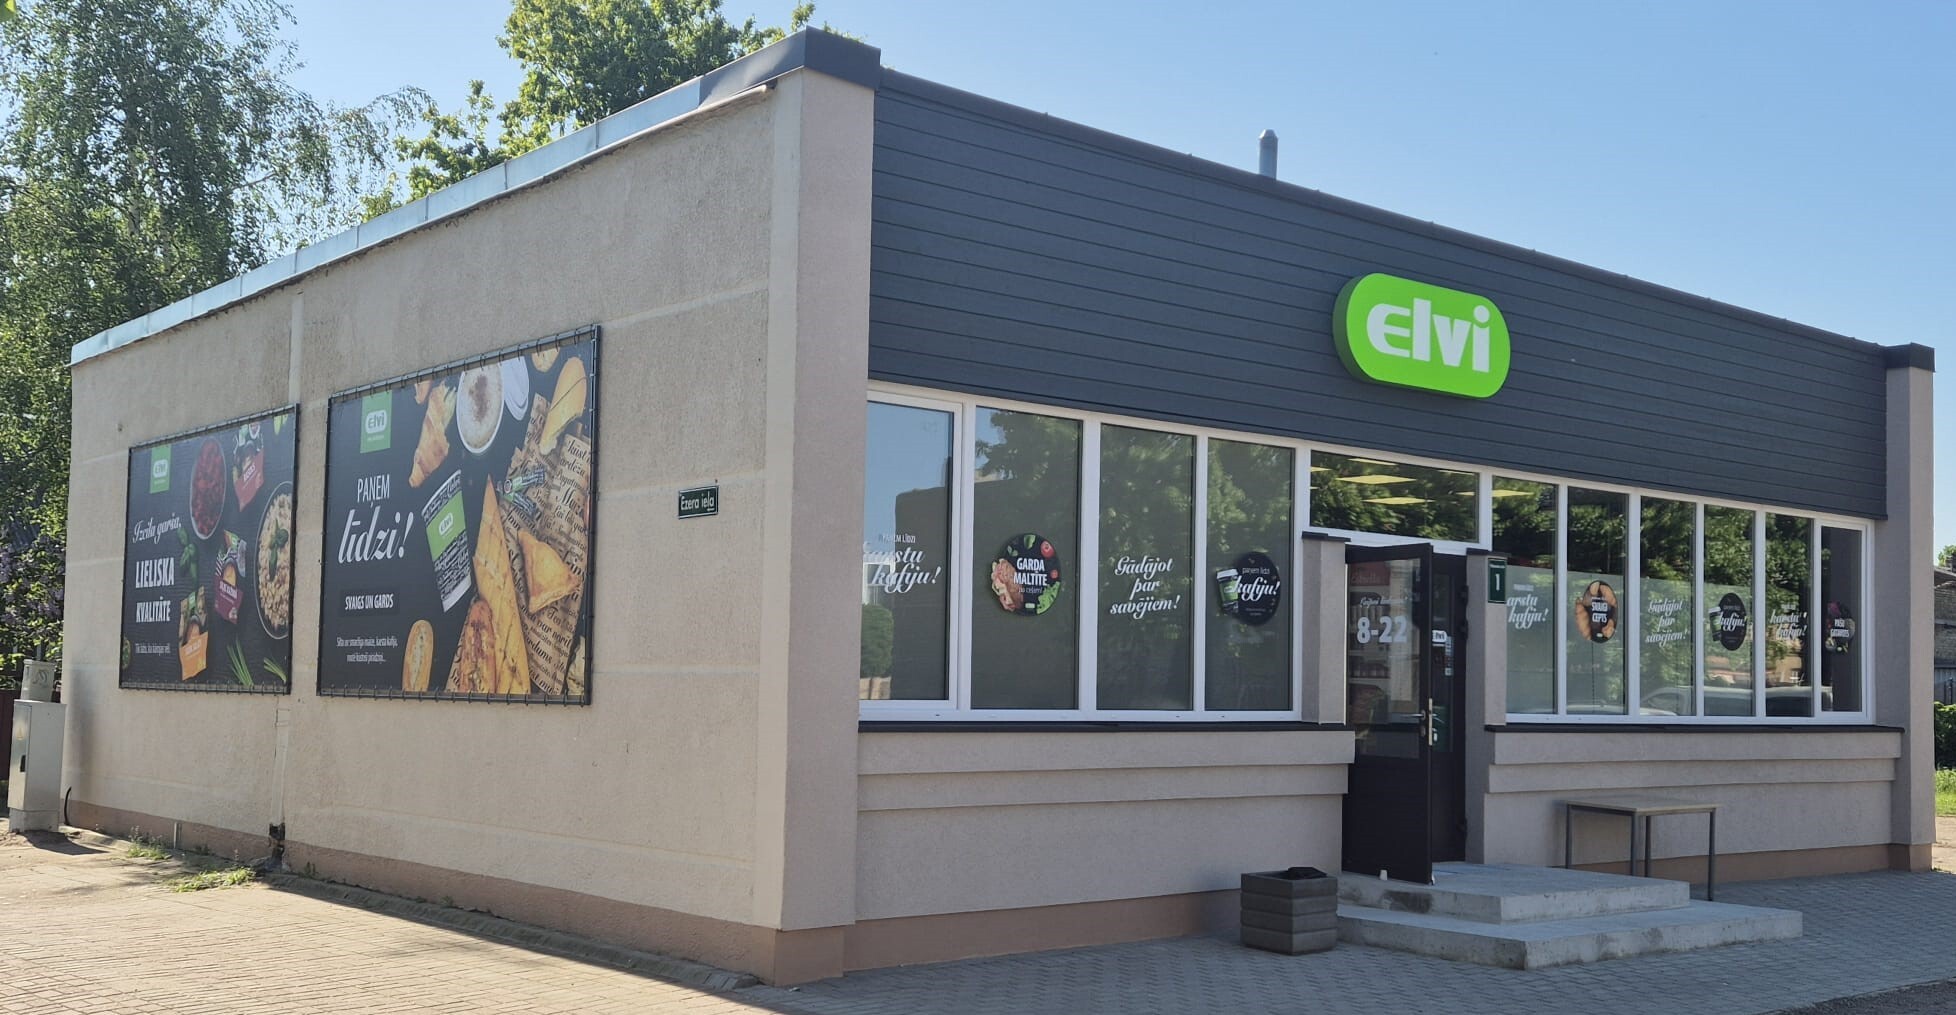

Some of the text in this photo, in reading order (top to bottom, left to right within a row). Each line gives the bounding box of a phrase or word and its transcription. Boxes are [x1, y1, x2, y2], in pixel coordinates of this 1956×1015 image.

[357, 474, 390, 508] PAŅEM
[681, 491, 715, 510] Ezera iela
[338, 505, 414, 563] līdzi!
[135, 557, 175, 589] LIELISKA
[1016, 558, 1045, 571] GARDA
[1115, 555, 1173, 580] Gādājot
[871, 563, 942, 593] kafiju!
[1014, 570, 1048, 586] MALTĪTE
[1129, 578, 1160, 600] par
[1233, 575, 1281, 602] kafiju!
[1495, 573, 1500, 591] 1
[135, 596, 171, 623] KVALITĀTE
[365, 595, 374, 609] UN
[374, 593, 394, 609] GARDS
[1110, 595, 1181, 619] savējiem!
[1507, 594, 1538, 607] arstu
[1357, 615, 1408, 643] 8-22
